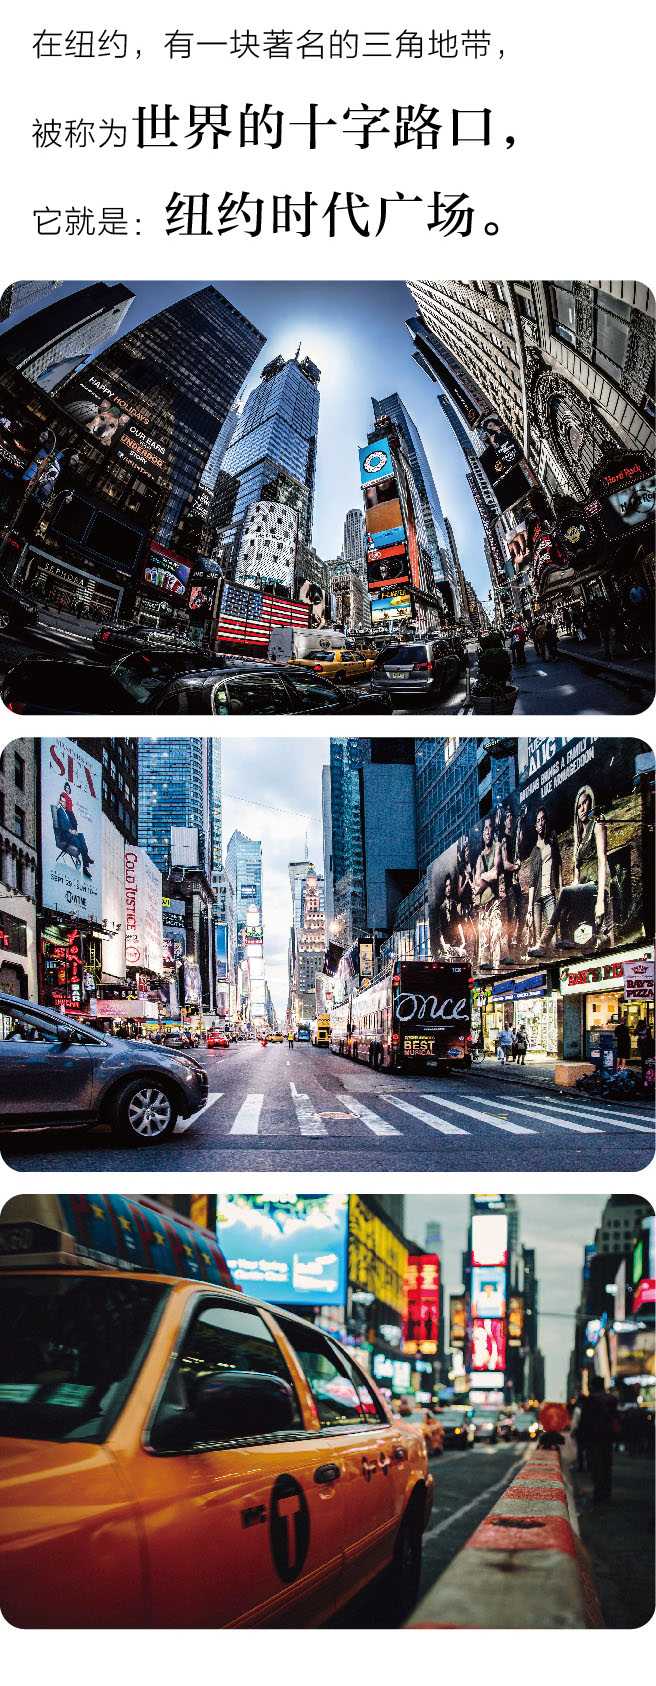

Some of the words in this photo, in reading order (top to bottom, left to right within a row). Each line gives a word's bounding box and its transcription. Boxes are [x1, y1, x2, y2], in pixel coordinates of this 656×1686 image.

[88, 376, 115, 398] HAPPY
[113, 396, 150, 425] HOLIDAYS
[129, 426, 146, 442] OUR
[120, 434, 164, 468] UNDERDOG
[129, 450, 148, 465] STORY
[604, 472, 624, 486] Hard
[44, 562, 85, 586] SEPHORA
[528, 737, 556, 777] AUG
[553, 745, 595, 789] ARMAGEDDON
[561, 756, 566, 770] A
[49, 744, 98, 800] SEX
[124, 852, 138, 884] COLD
[124, 884, 138, 931] JUSTICE
[567, 965, 602, 987] RAY'S
[626, 979, 654, 989] RAY'S
[72, 984, 80, 1002] BAR
[626, 989, 655, 998] PIZZA
[403, 1040, 436, 1050] BEST
[277, 1494, 300, 1568] T
